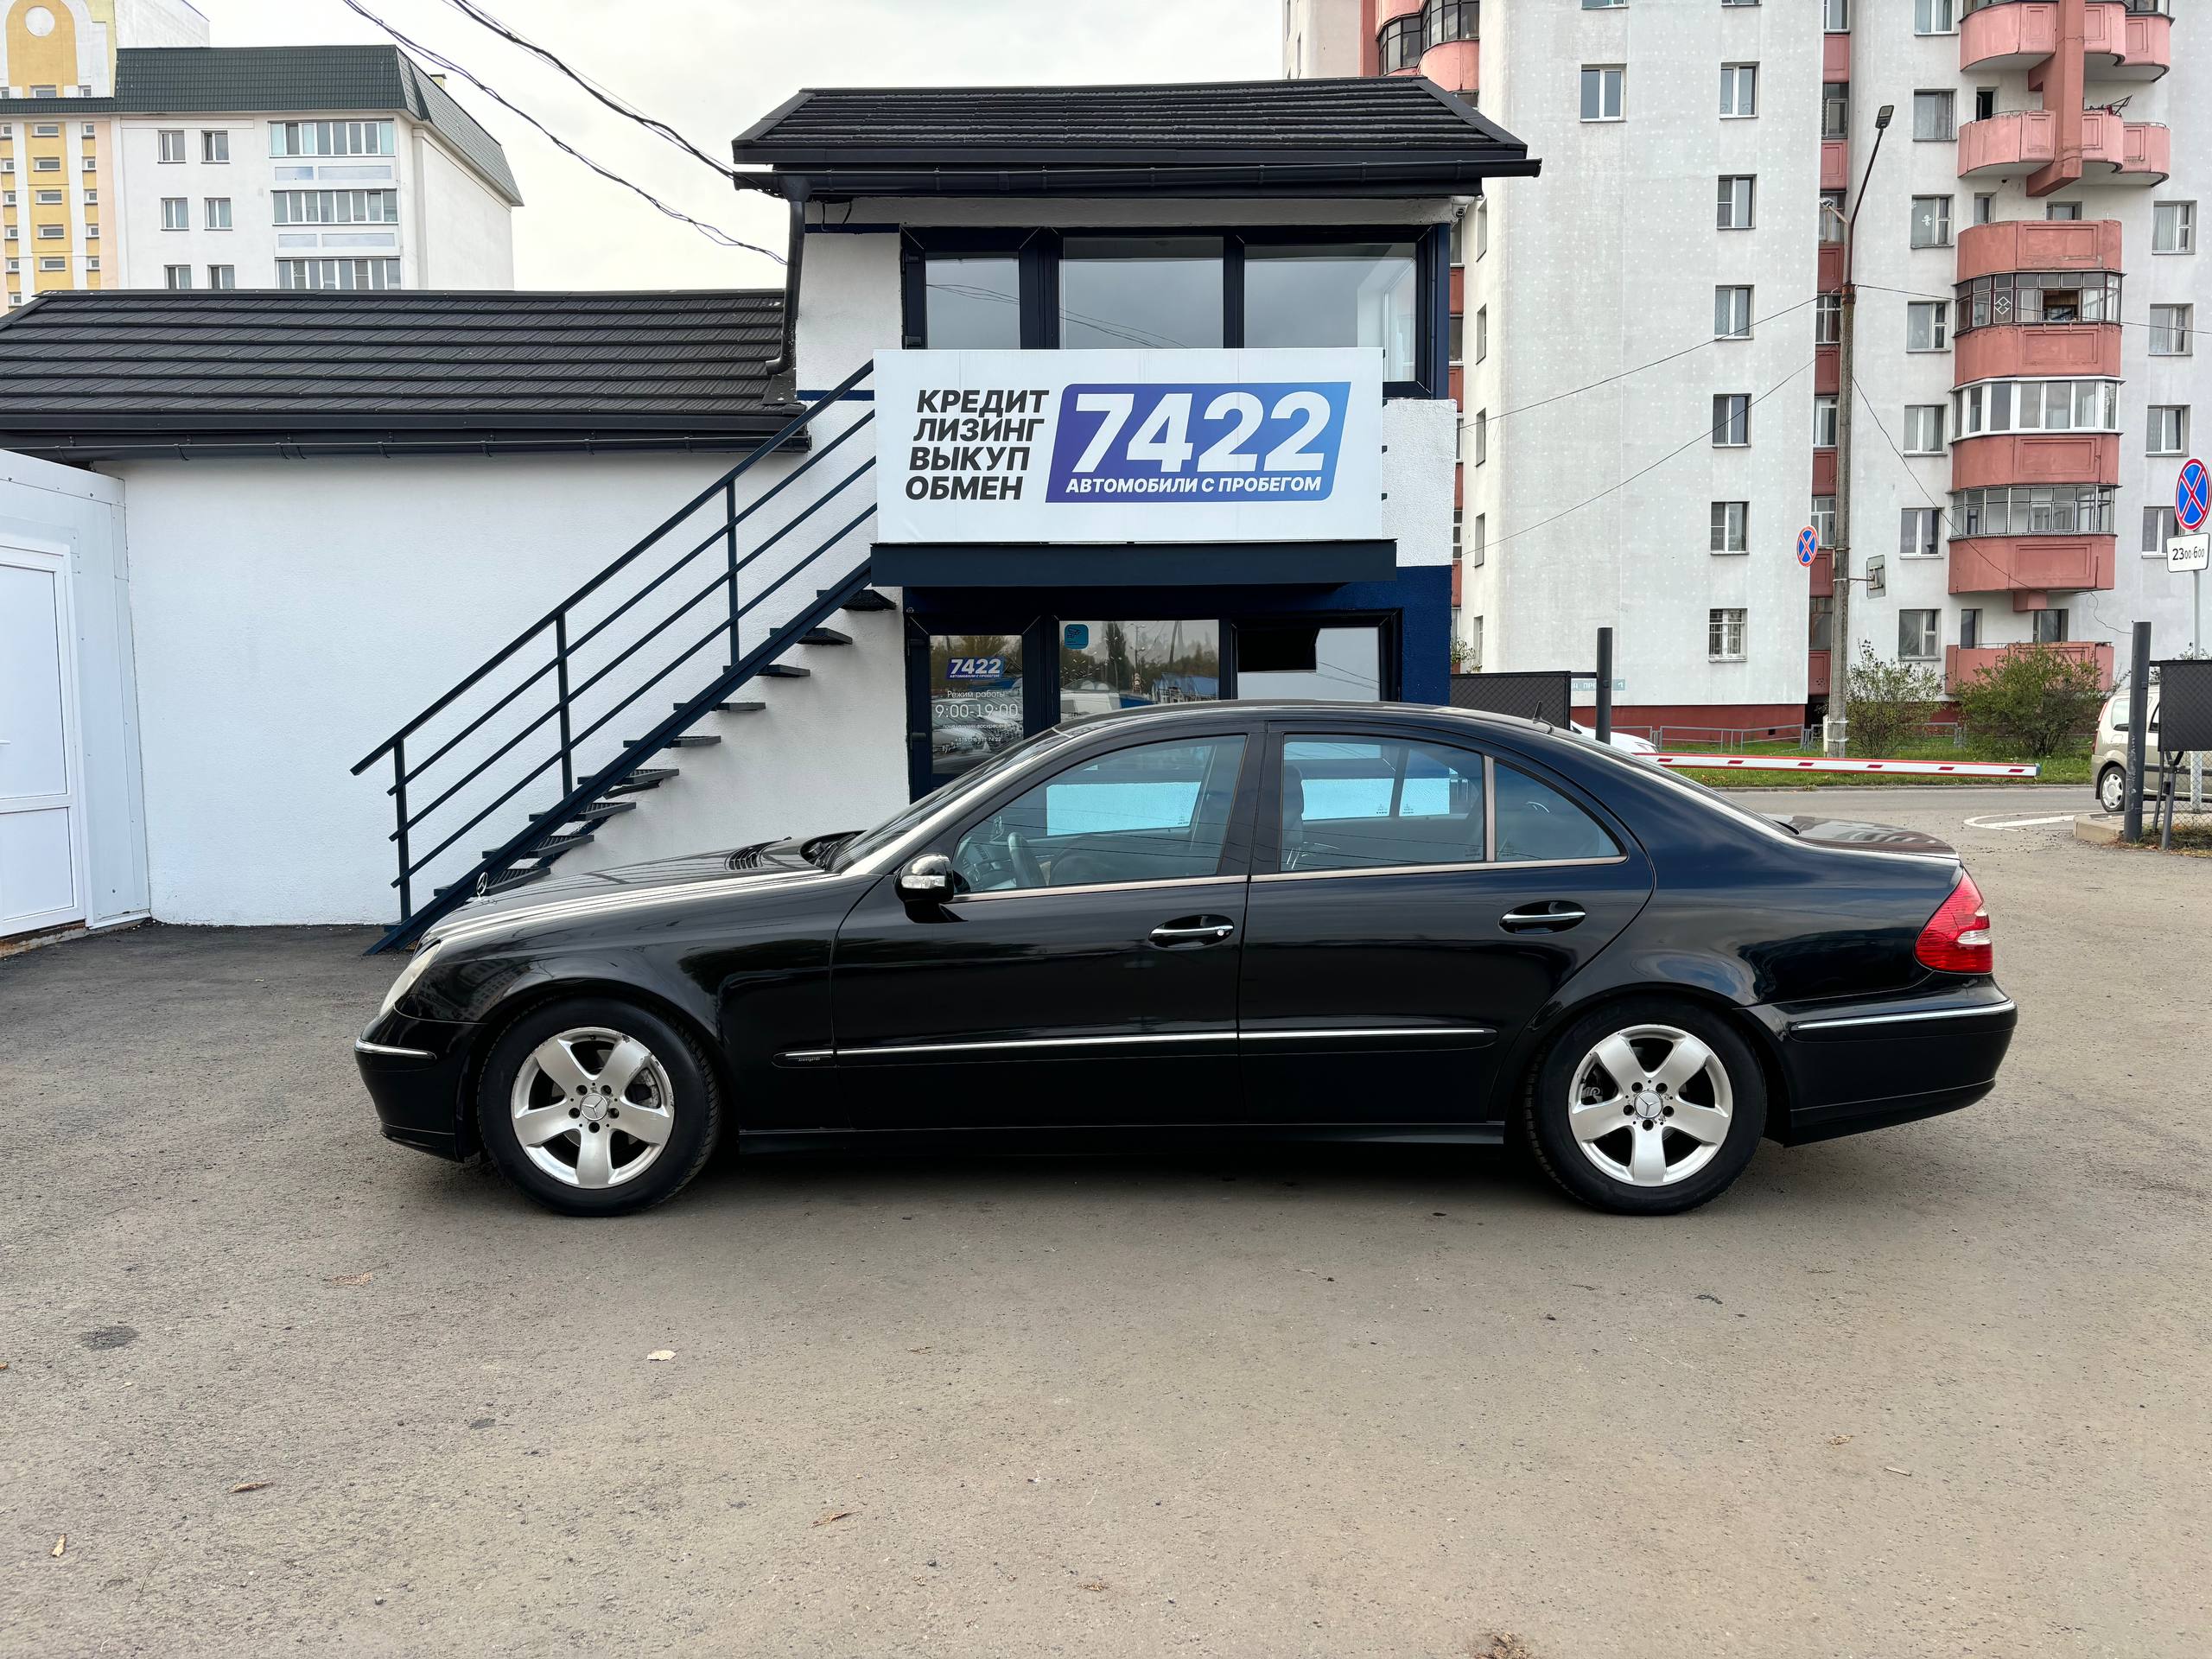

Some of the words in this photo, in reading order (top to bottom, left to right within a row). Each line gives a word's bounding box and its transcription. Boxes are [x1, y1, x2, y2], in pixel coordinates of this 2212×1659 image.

[917, 389, 1050, 418] КРЕДИТ
[912, 418, 1045, 442] ЛИЗИНГ
[1072, 391, 1331, 473] 7422
[909, 447, 1030, 471] ВЫКУП
[906, 475, 1023, 500] ОБМЕН
[1065, 478, 1198, 493] АВТОМОБИЛИ
[1202, 477, 1216, 493] С
[1218, 476, 1322, 493] ПРОБЕГОМ
[950, 658, 1001, 675] 7422
[976, 690, 1005, 700] работы
[935, 703, 1019, 718] 9:00-19:00
